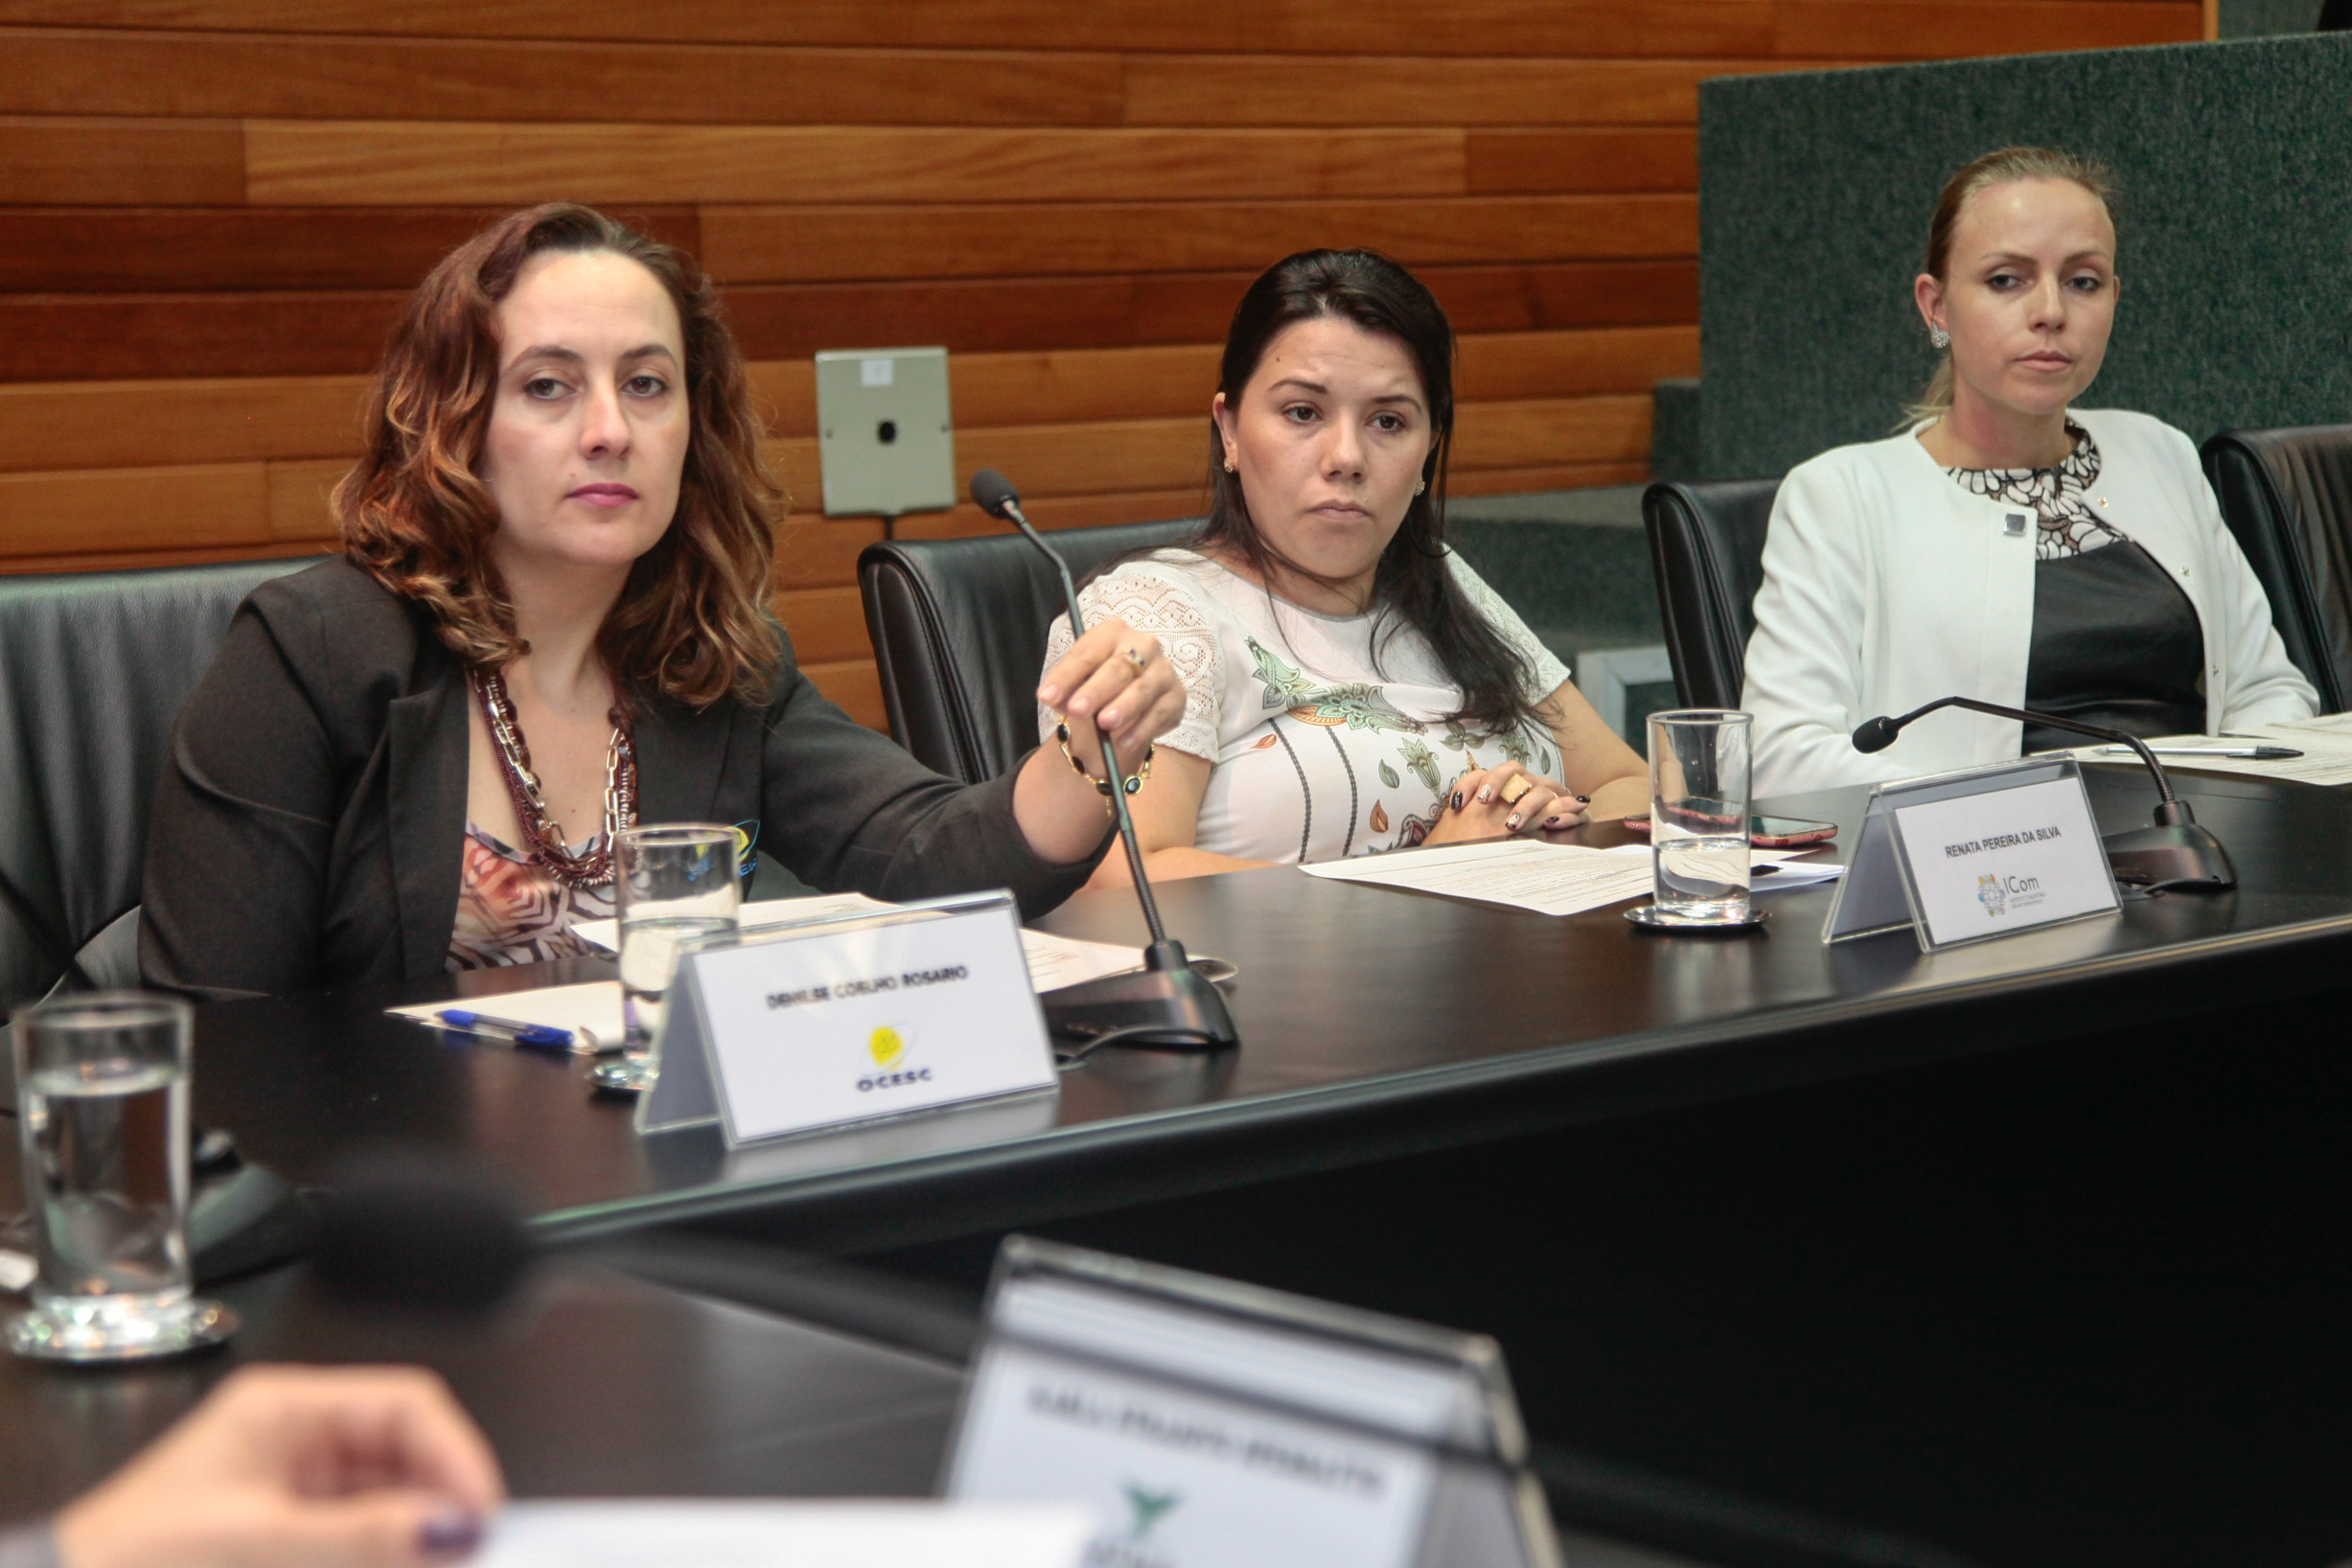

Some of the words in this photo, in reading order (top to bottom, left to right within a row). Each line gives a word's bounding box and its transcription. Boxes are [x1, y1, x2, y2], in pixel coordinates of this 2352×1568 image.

[1945, 841, 1982, 858] RENATA
[1982, 834, 2021, 851] PEREIRA
[2021, 830, 2036, 844] DA
[2036, 826, 2062, 841] SILVA
[2003, 876, 2040, 894] ICom
[835, 977, 897, 999] COELHO
[857, 1069, 933, 1092] OCESC
